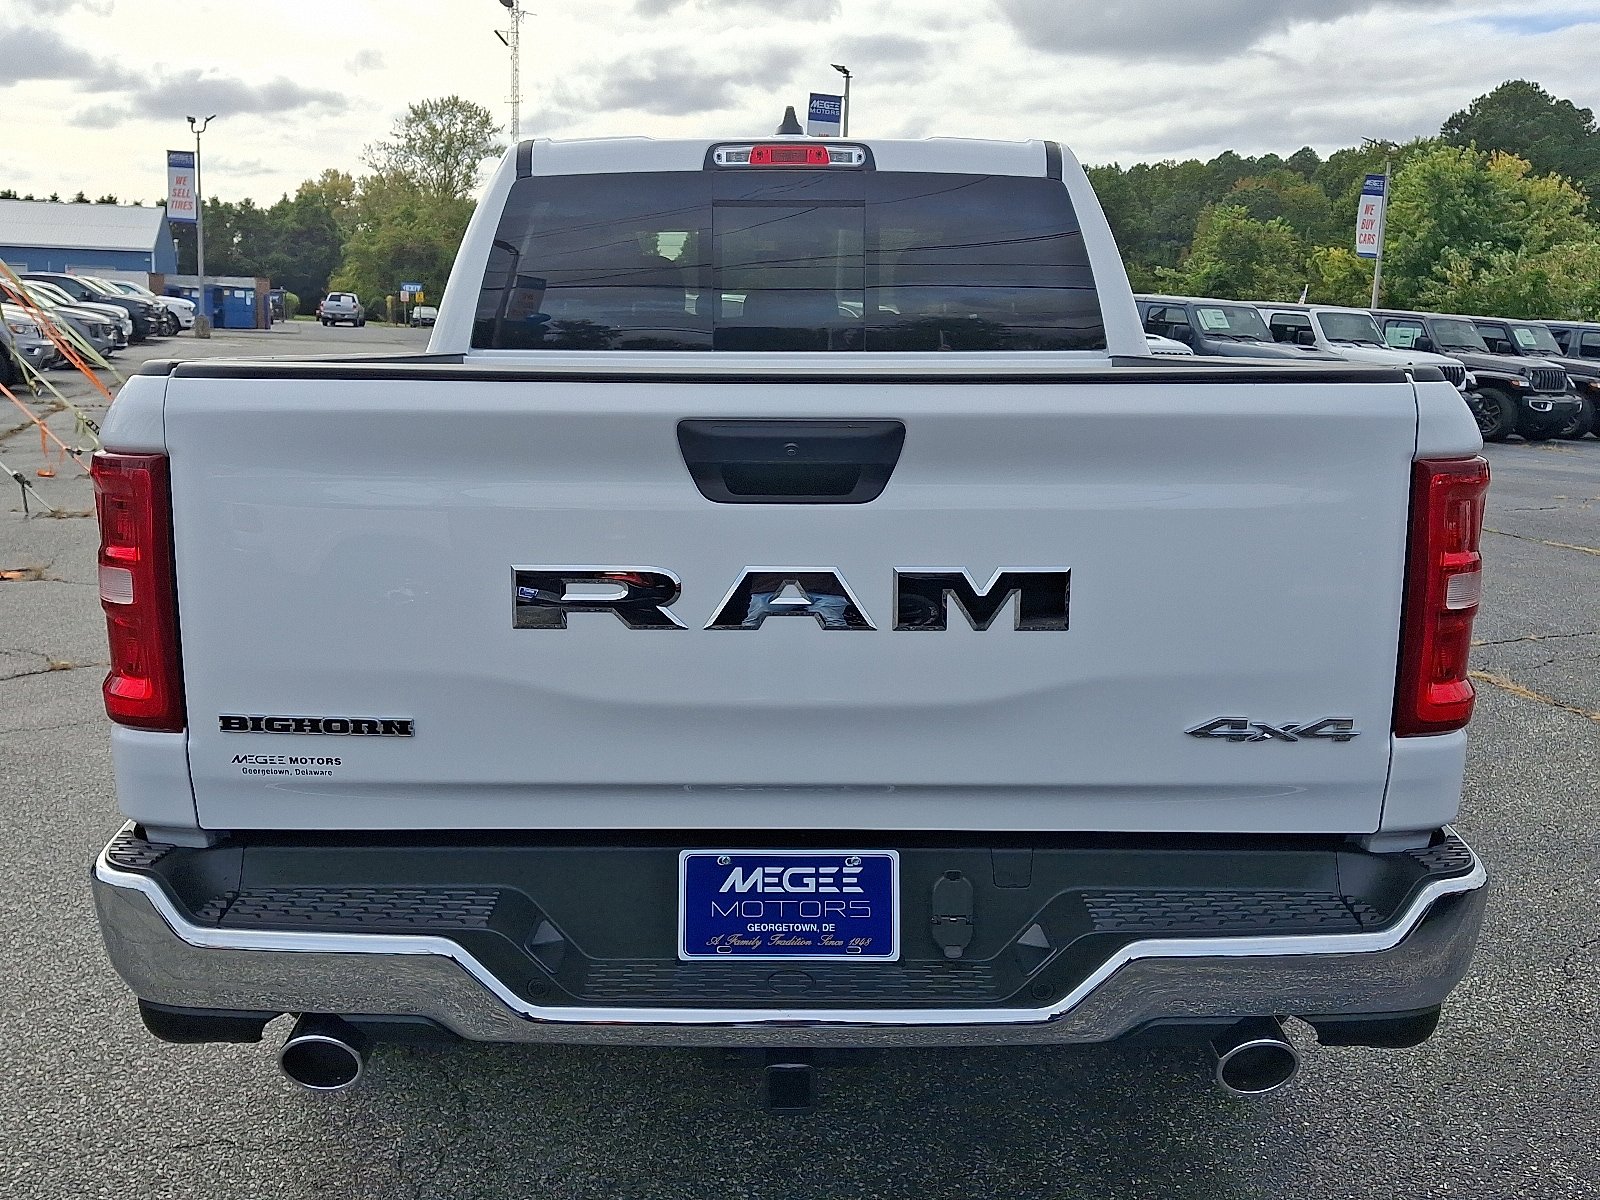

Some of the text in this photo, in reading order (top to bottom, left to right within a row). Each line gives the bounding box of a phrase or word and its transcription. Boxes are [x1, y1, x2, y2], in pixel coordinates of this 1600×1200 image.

[811, 100, 840, 110] MEGEE
[810, 108, 840, 116] MOTORS
[175, 176, 187, 185] WE
[172, 188, 190, 198] SELL
[171, 200, 193, 211] TIRES
[1364, 203, 1375, 216] WE
[1361, 218, 1375, 231] BUY
[1359, 232, 1376, 245] CARS
[510, 565, 1073, 631] RAM
[218, 713, 416, 738] BIGHORN
[1184, 716, 1361, 742] 4x4
[231, 755, 342, 766] MEGEE MOTORS
[242, 767, 333, 776] Georgetown, Delaware
[718, 866, 864, 893] MEGEE
[711, 900, 871, 918] MOTORS
[747, 923, 836, 933] GEORGETOWN, DE
[706, 933, 724, 946] A
[725, 933, 762, 949] Family
[767, 933, 813, 946] Tradition
[817, 934, 844, 946] Since
